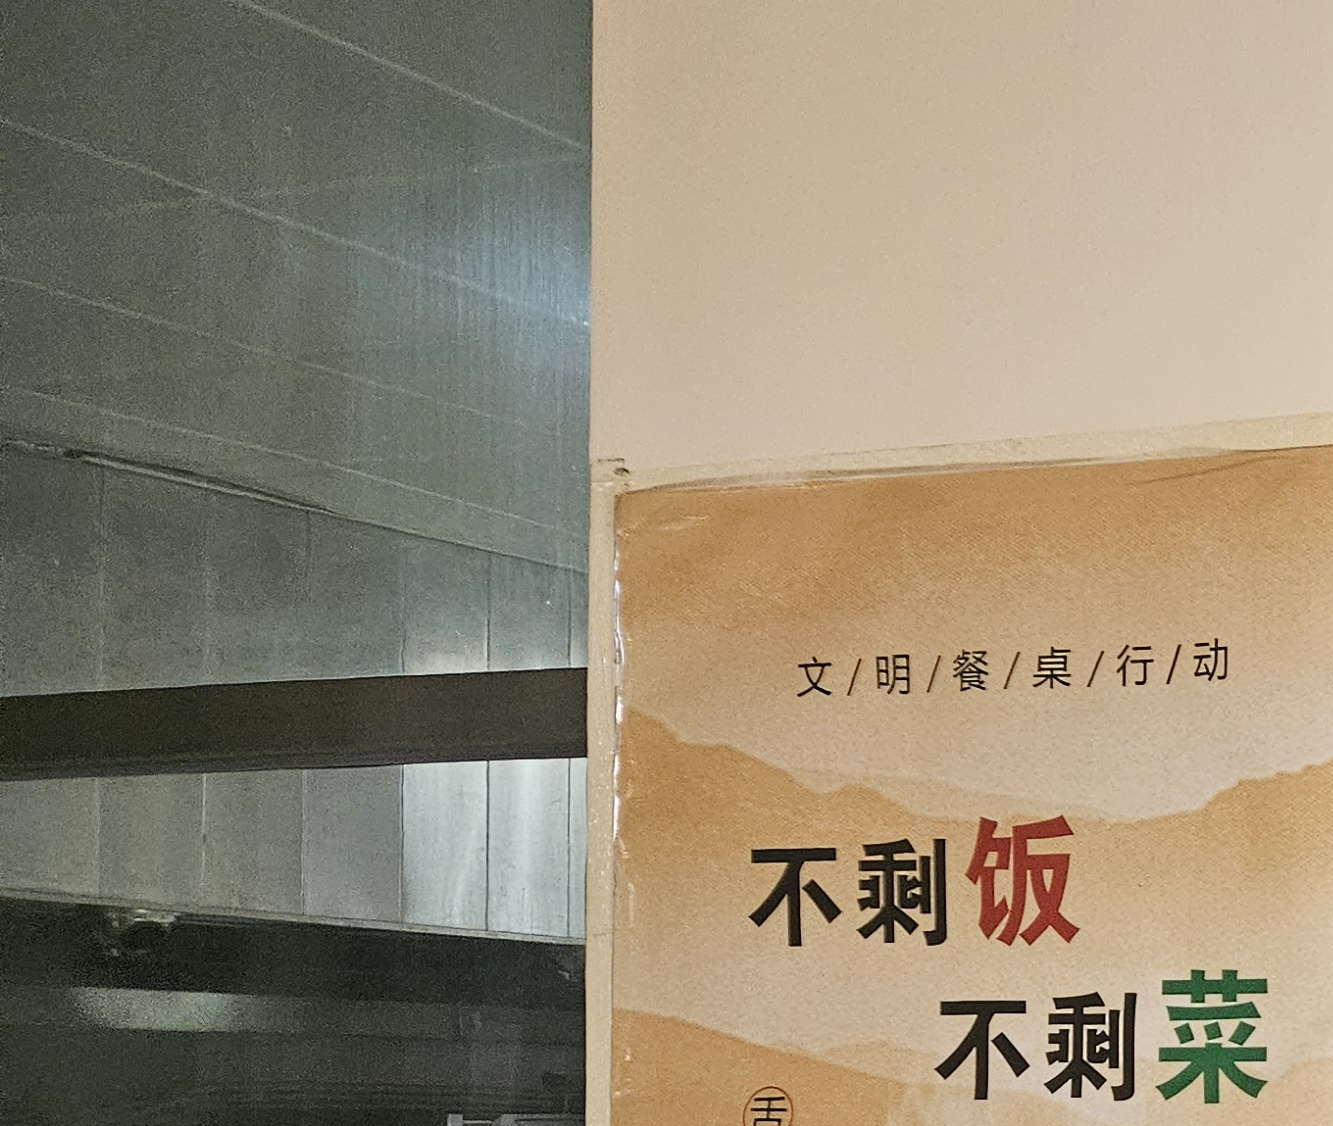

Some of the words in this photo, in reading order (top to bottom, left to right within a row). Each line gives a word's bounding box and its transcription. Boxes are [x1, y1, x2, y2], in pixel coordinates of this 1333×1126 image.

[749, 815, 1080, 947] 不剩饭
[935, 968, 1269, 1104] 不剩菜
